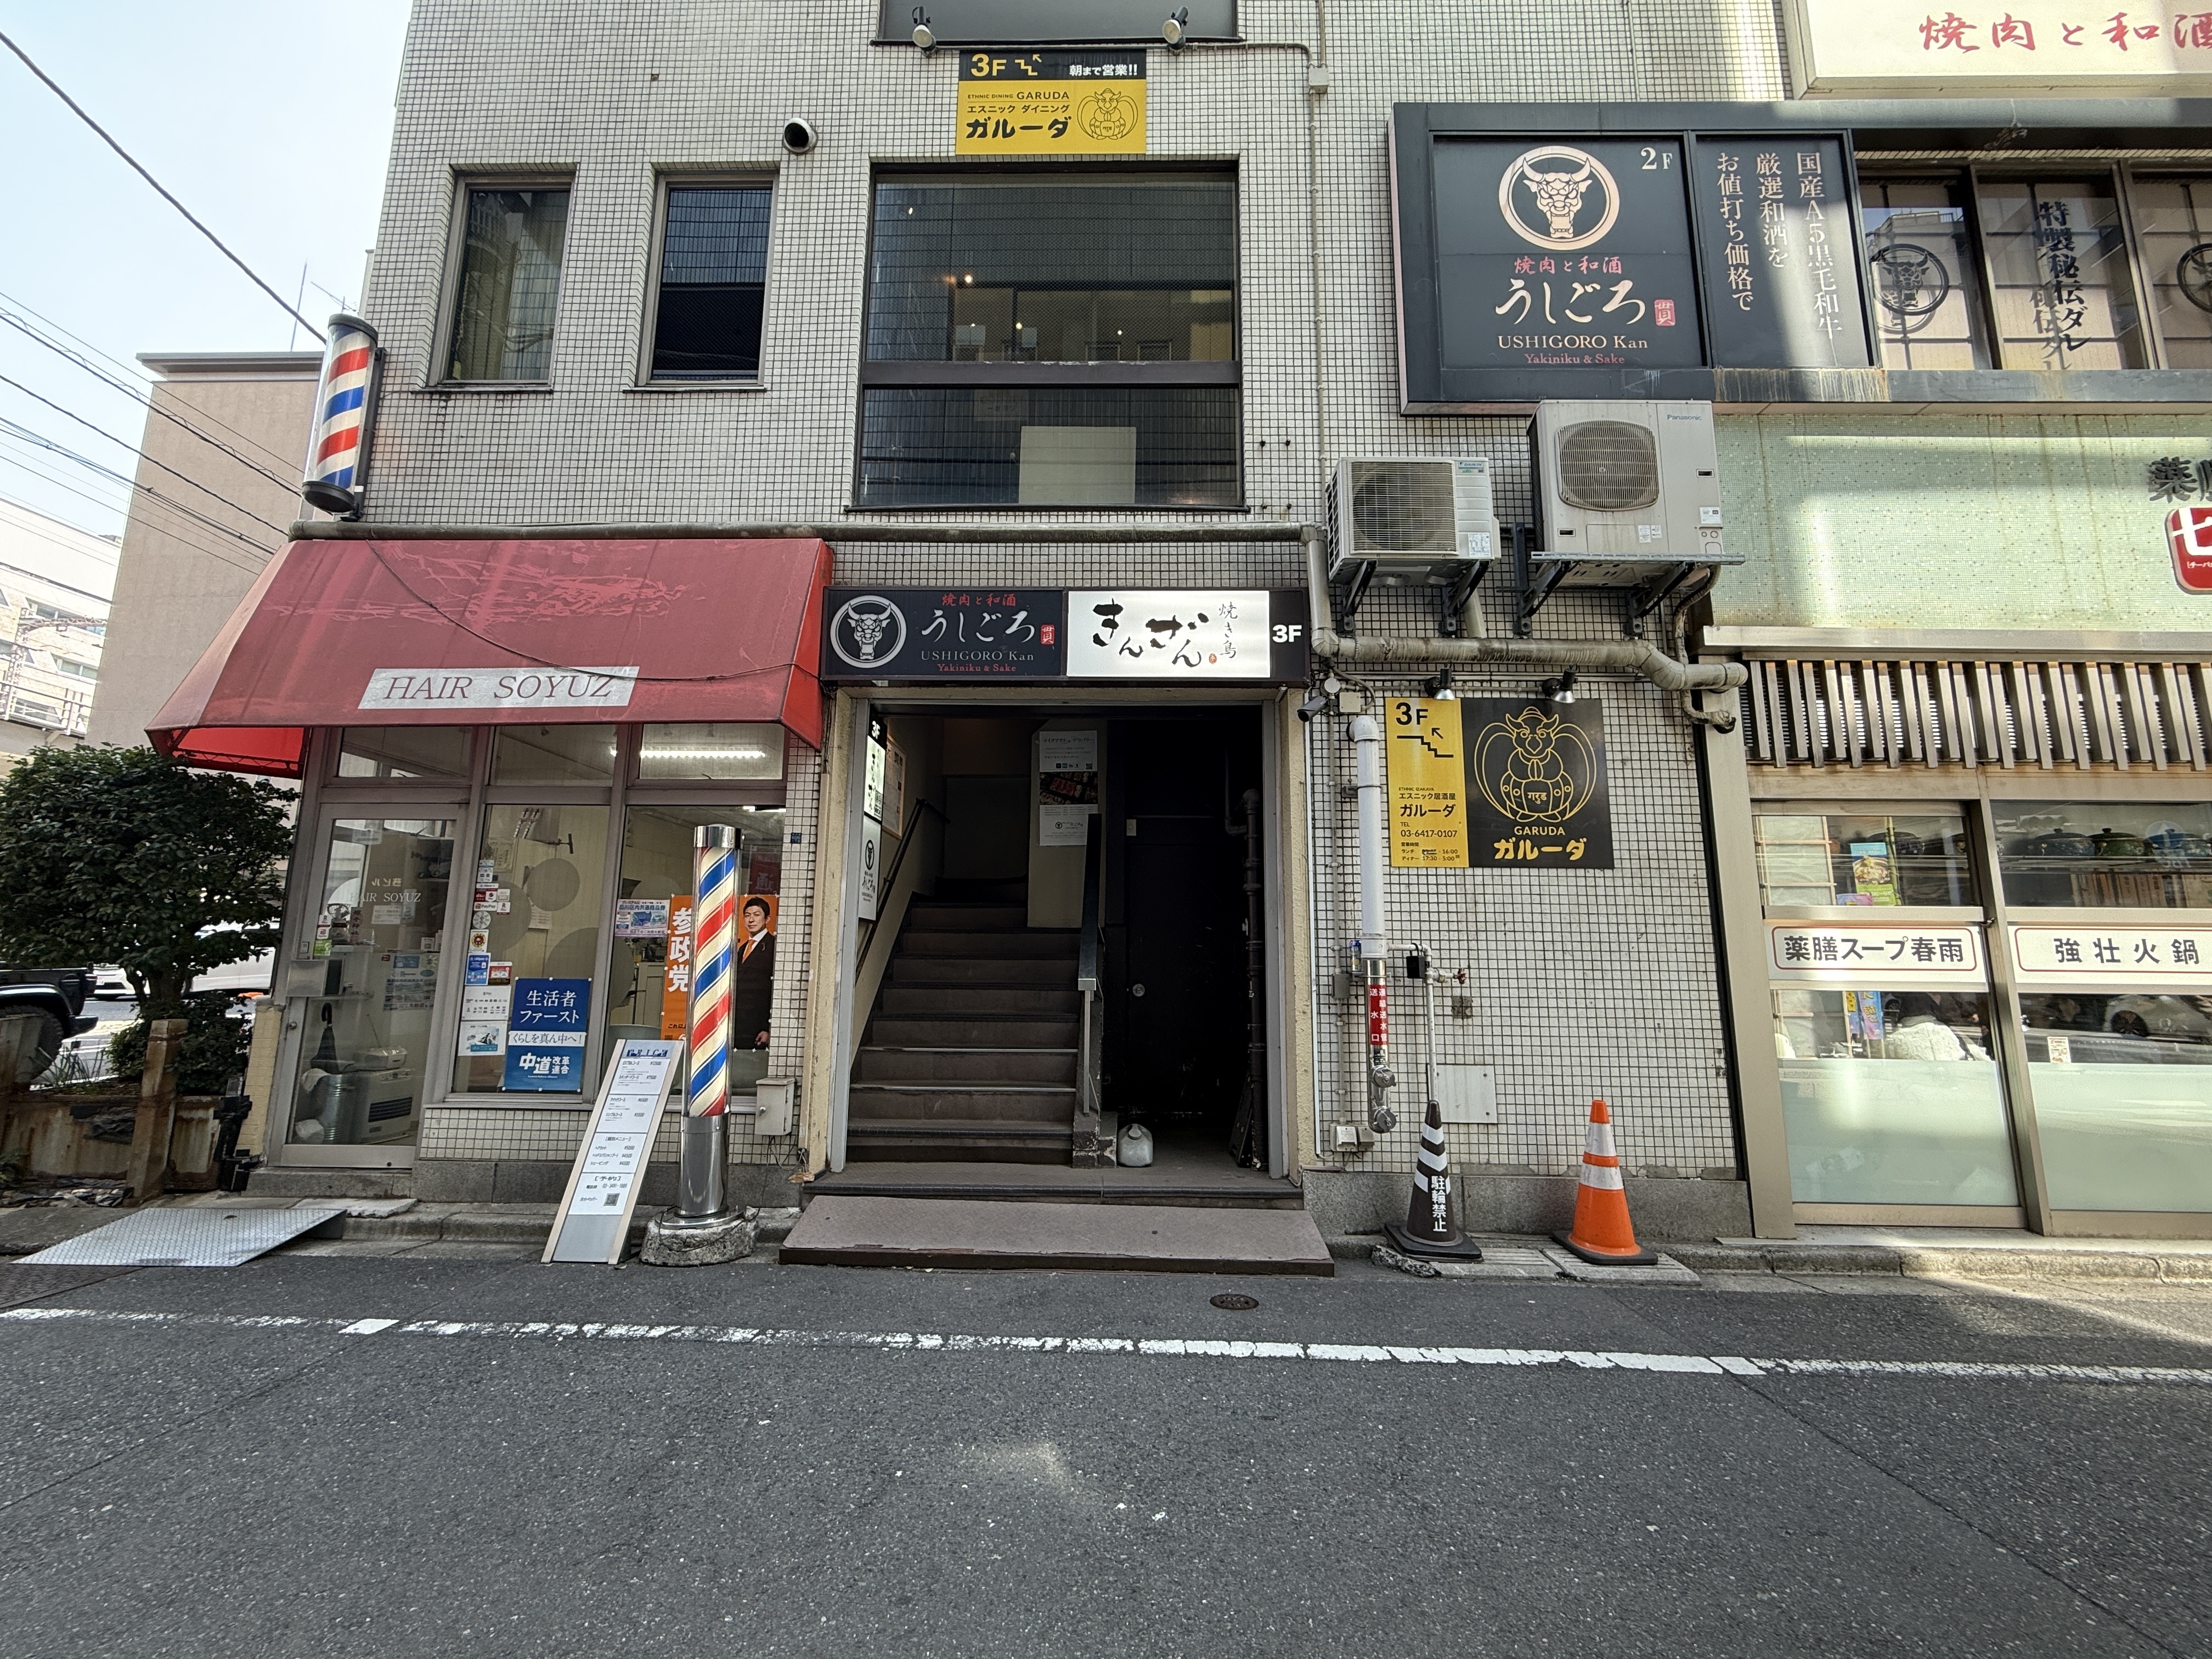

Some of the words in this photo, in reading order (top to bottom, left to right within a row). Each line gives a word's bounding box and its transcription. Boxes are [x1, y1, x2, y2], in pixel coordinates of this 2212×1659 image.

[970, 54, 1007, 76] 3F
[1069, 64, 1137, 76] 朝まで営業!!
[1017, 91, 1070, 99] GARUDA
[967, 104, 1015, 114] エスニック
[1022, 104, 1070, 114] ダイニング
[966, 116, 1072, 138] ガルーダ
[1641, 147, 1672, 171] 2F
[1756, 152, 1788, 268] 厳選和酒を
[1717, 152, 1754, 312] お値打ち価格で
[1514, 256, 1622, 275] 焼肉と和酒
[2039, 201, 2091, 352] 特製秘伝ダレ
[1495, 278, 1645, 324] うしごろ
[1498, 335, 1607, 349] USHIGORO
[1613, 335, 1648, 349] Kan
[1525, 353, 1581, 364] Yakiniku
[1583, 354, 1593, 364] &
[1595, 353, 1625, 364] Sake
[942, 593, 1016, 607] 焼肉と和酒
[922, 610, 1035, 643] うしごろ
[1093, 597, 1209, 667] きんざん
[1218, 601, 1238, 659] 焼き鳥
[1272, 625, 1302, 642] 3F
[921, 651, 1003, 661] USHIGORO
[1009, 651, 1034, 661] Kan
[383, 676, 473, 700] HAIR
[494, 675, 618, 699] SOYUZ
[1395, 702, 1429, 725] 3F
[1400, 803, 1456, 817] ガルーダ
[1514, 826, 1566, 836] GARUDA
[1493, 837, 1587, 861] ガルーダ
[383, 893, 421, 902] SOYUZ
[668, 907, 692, 992] 参政党
[1784, 935, 1964, 963] 薬膳スープ春雨
[2054, 938, 2200, 965] 強壮火鍋
[526, 990, 577, 1007] 生活者
[520, 1009, 579, 1024] ファースト
[1369, 989, 1379, 1041] 送水口
[1379, 989, 1387, 1041] 連結送水管
[513, 1032, 582, 1045] くらしを真ん中へ！
[519, 1052, 552, 1074] 中道
[551, 1065, 570, 1074] 連合
[552, 1056, 570, 1065] 改革
[1431, 1175, 1447, 1232] 駐輪禁止
